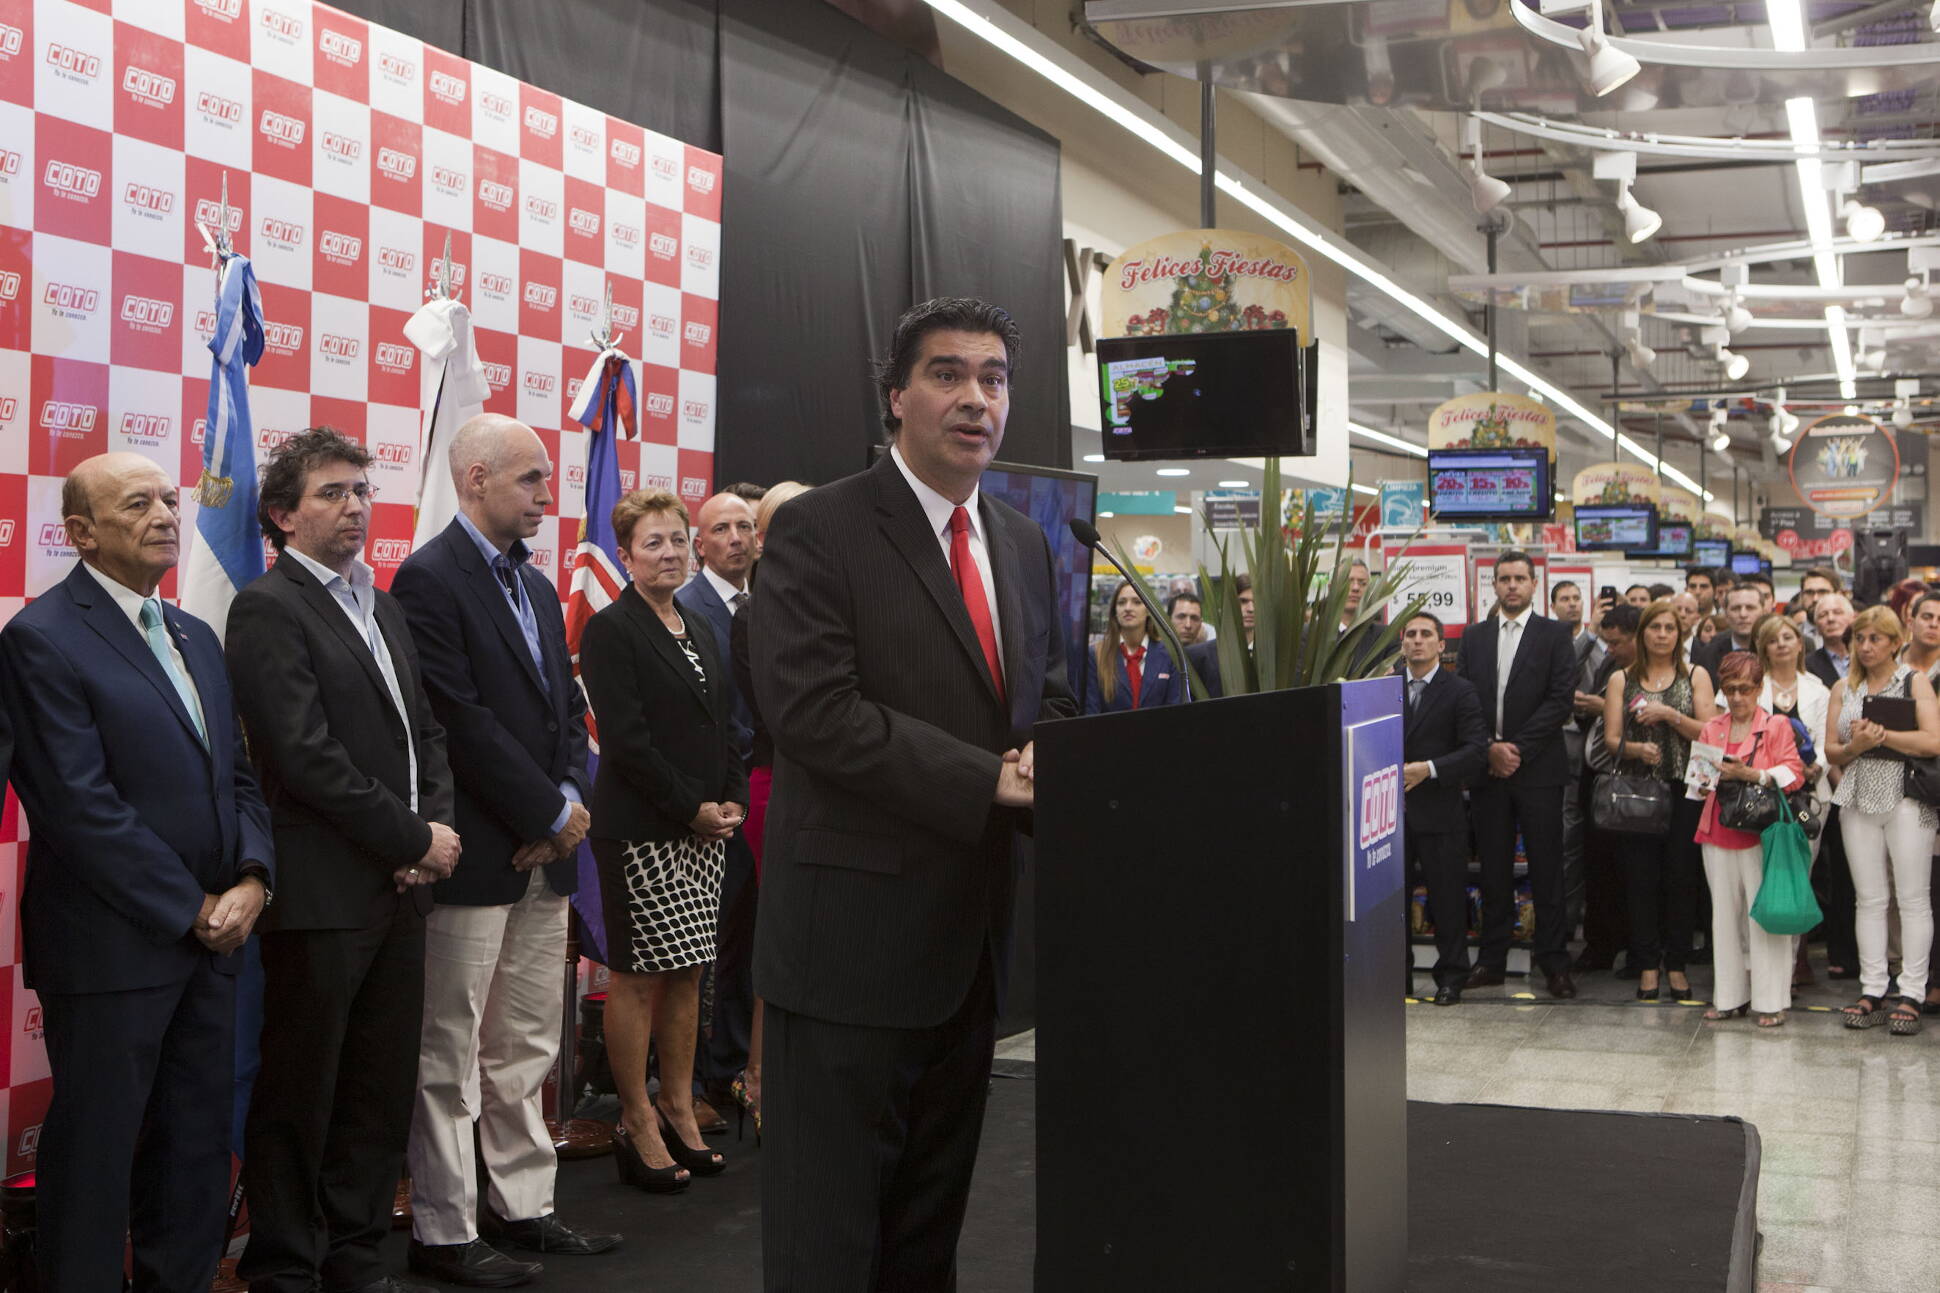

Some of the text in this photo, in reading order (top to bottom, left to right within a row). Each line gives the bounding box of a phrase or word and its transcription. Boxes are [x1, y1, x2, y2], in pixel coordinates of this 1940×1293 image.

[262, 9, 302, 39] COTO
[46, 42, 101, 78] COTO
[319, 28, 362, 63] COTO
[122, 64, 177, 105] COTO
[429, 70, 467, 102] COTO
[197, 91, 242, 122] COTO
[524, 105, 559, 136] COTO
[260, 109, 305, 144] COTO
[322, 131, 361, 160] COTO
[377, 146, 416, 178] COTO
[44, 159, 102, 198] COTO
[431, 166, 465, 191] COTO
[124, 182, 175, 214] COTO
[478, 179, 513, 208] COTO
[526, 196, 557, 218] COTO
[261, 217, 303, 245] COTO
[569, 208, 601, 235] COTO
[320, 230, 362, 260] COTO
[378, 247, 414, 271] COTO
[479, 271, 512, 294] COTO
[1121, 251, 1297, 290] Felices Fiestas
[44, 282, 99, 313] COTO
[523, 281, 557, 308] COTO
[569, 295, 599, 316] COTO
[120, 294, 174, 328] COTO
[650, 314, 676, 334] COTO
[320, 333, 360, 358] COTO
[375, 342, 415, 369] COTO
[524, 371, 555, 391] COTO
[40, 400, 98, 432] COTO
[646, 392, 675, 414] COTO
[1440, 405, 1549, 427] Felices Fiestas
[119, 412, 171, 438] COTO
[376, 442, 412, 463] COTO
[681, 477, 707, 498] COTO
[371, 539, 410, 561] COTO
[1360, 764, 1398, 850] COTO
